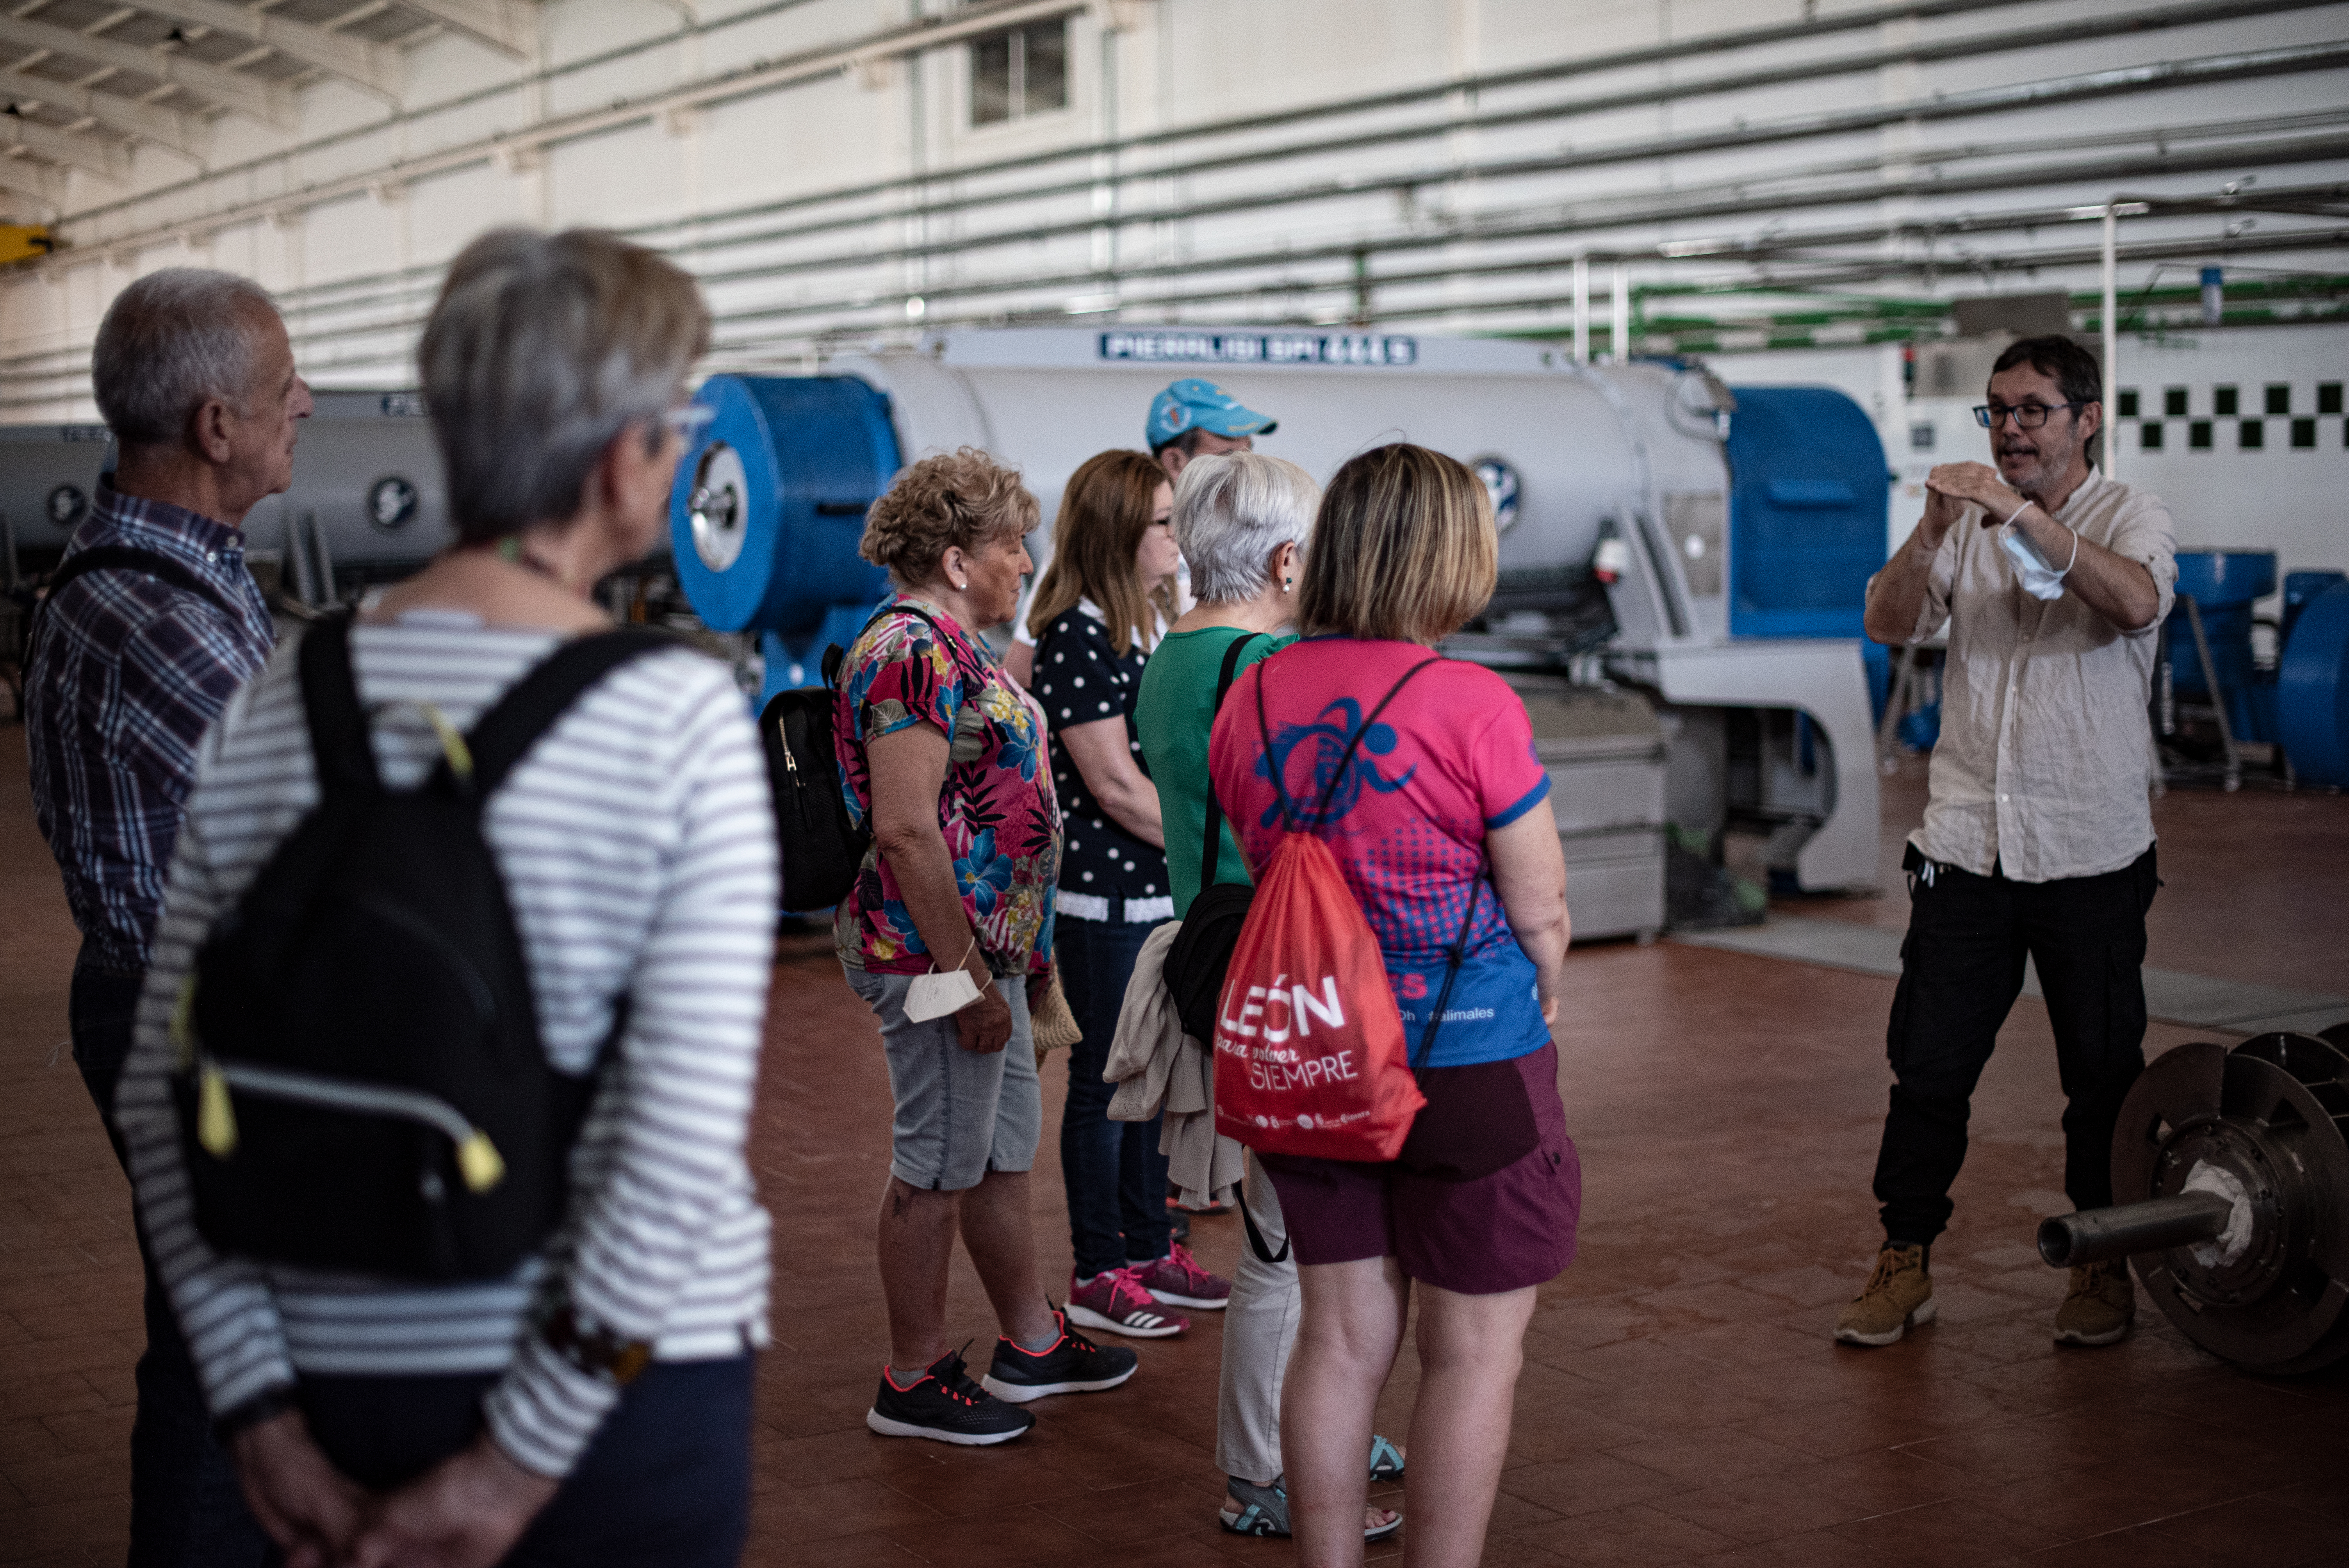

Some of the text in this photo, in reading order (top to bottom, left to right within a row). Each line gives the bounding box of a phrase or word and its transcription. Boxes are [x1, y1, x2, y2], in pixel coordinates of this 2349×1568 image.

[1220, 973, 1345, 1043] LEÓN
[1215, 1032, 1300, 1063] para volver
[1250, 1049, 1359, 1090] SIEMPRE
